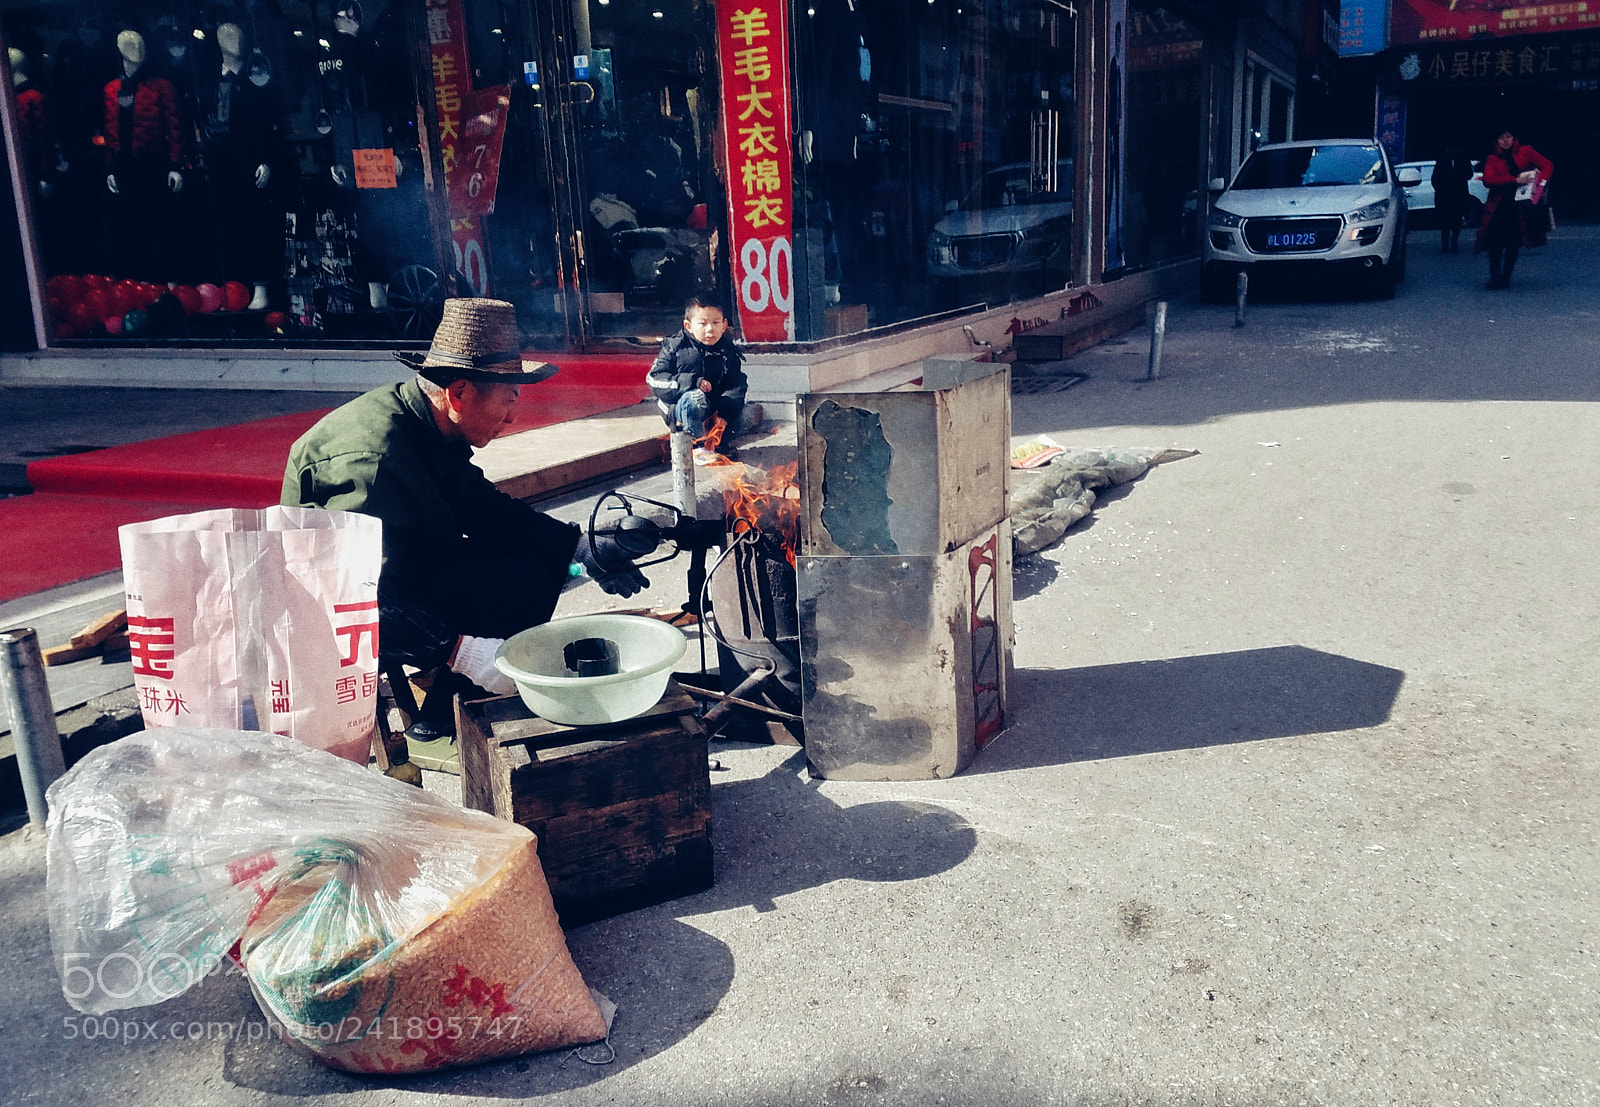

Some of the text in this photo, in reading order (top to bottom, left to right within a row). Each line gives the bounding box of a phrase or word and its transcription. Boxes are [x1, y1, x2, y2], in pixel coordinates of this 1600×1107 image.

[1427, 45, 1561, 80] 小吴仔美食汇
[729, 6, 786, 229] 羊毛大衣棉衣
[740, 236, 793, 314] 80
